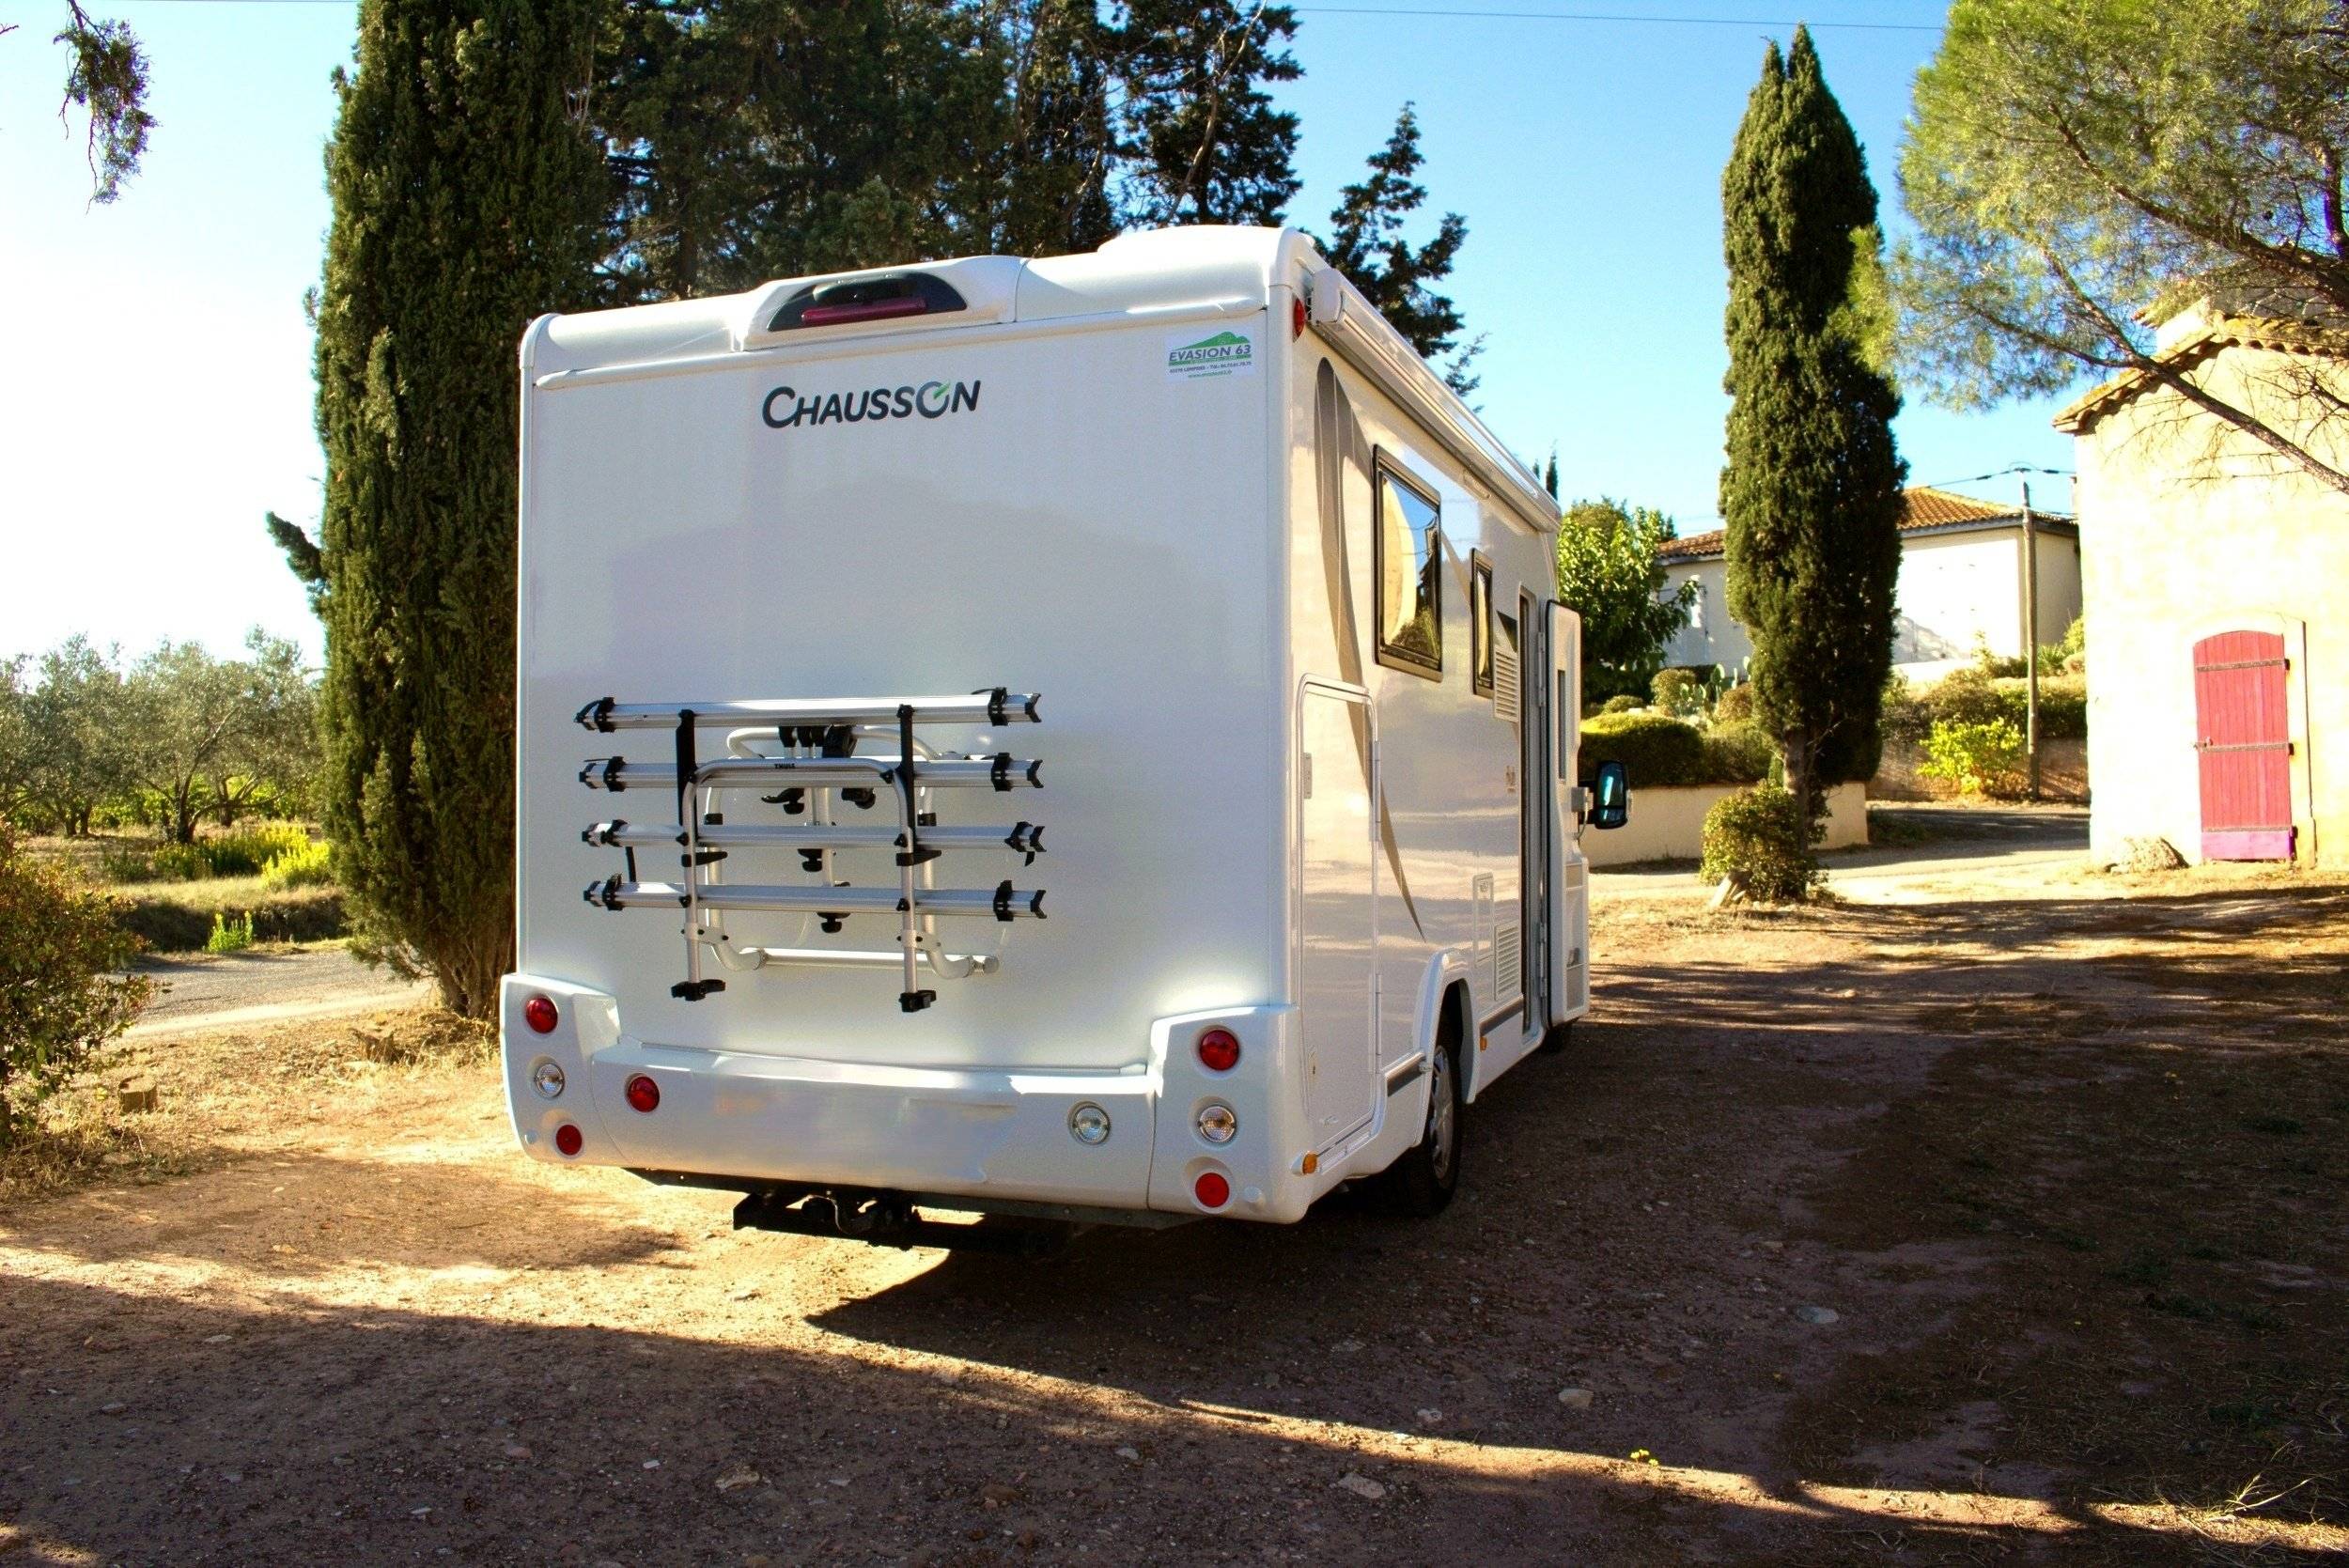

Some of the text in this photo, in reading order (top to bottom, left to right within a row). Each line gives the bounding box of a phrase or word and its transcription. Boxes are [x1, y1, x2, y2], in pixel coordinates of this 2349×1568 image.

[1169, 347, 1231, 361] EVASION
[1236, 345, 1252, 355] 63
[762, 380, 981, 428] CHAUSSON
